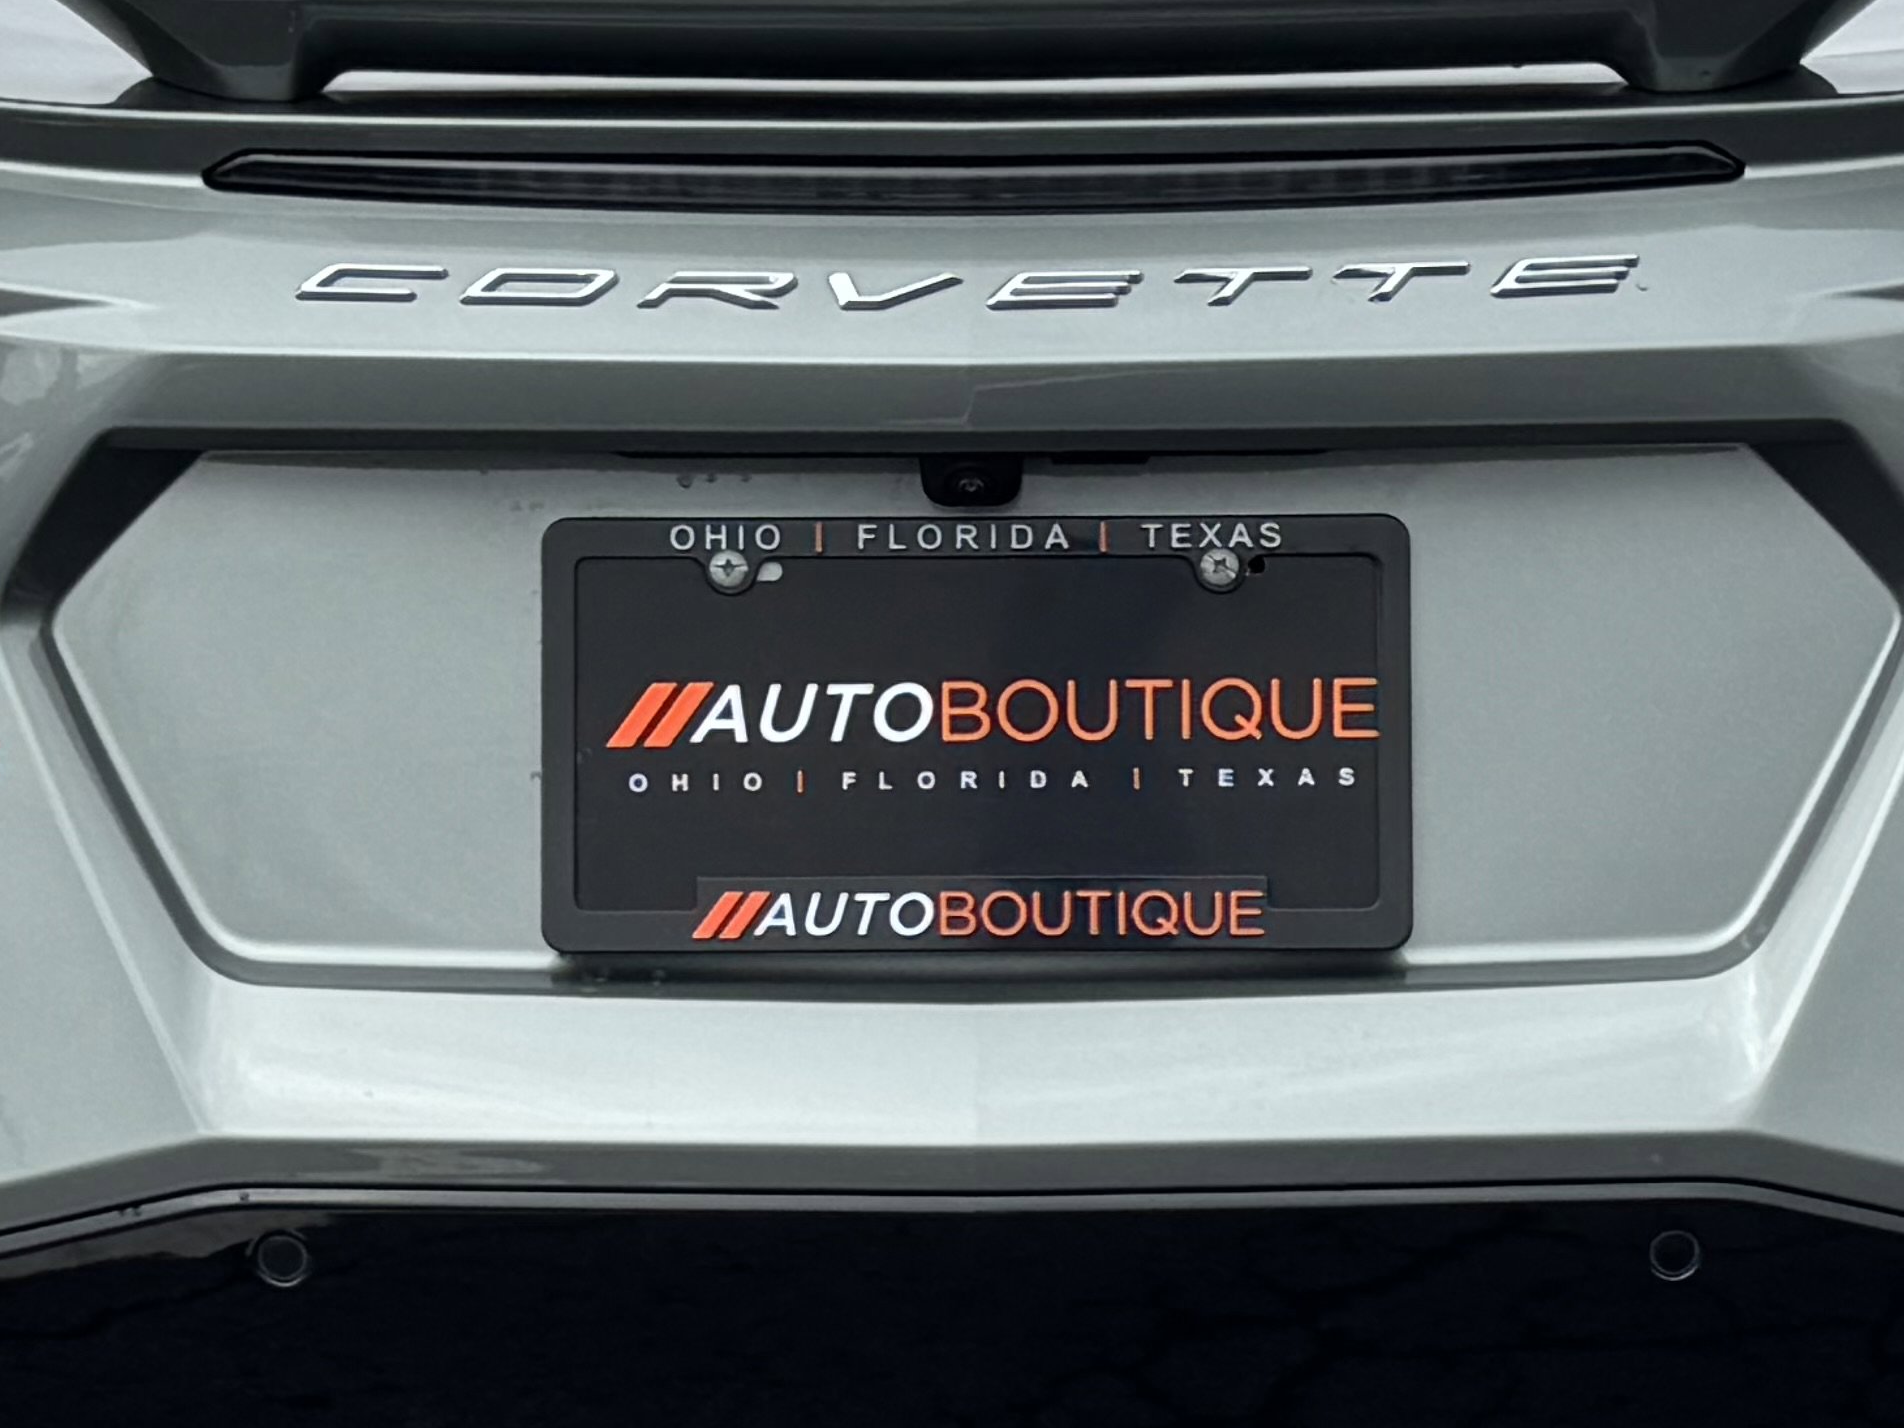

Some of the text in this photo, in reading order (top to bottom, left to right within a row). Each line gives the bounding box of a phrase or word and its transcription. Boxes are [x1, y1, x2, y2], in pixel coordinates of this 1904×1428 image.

[295, 253, 1640, 311] CORVETTE
[669, 522, 1283, 552] OHIO FLORIDA TEXAS
[690, 676, 1381, 744] AUTOBOUTIQUE
[628, 766, 1357, 793] OHIO FLORIDA TEXAS
[752, 889, 1267, 939] AUTOBOUTIQUE
